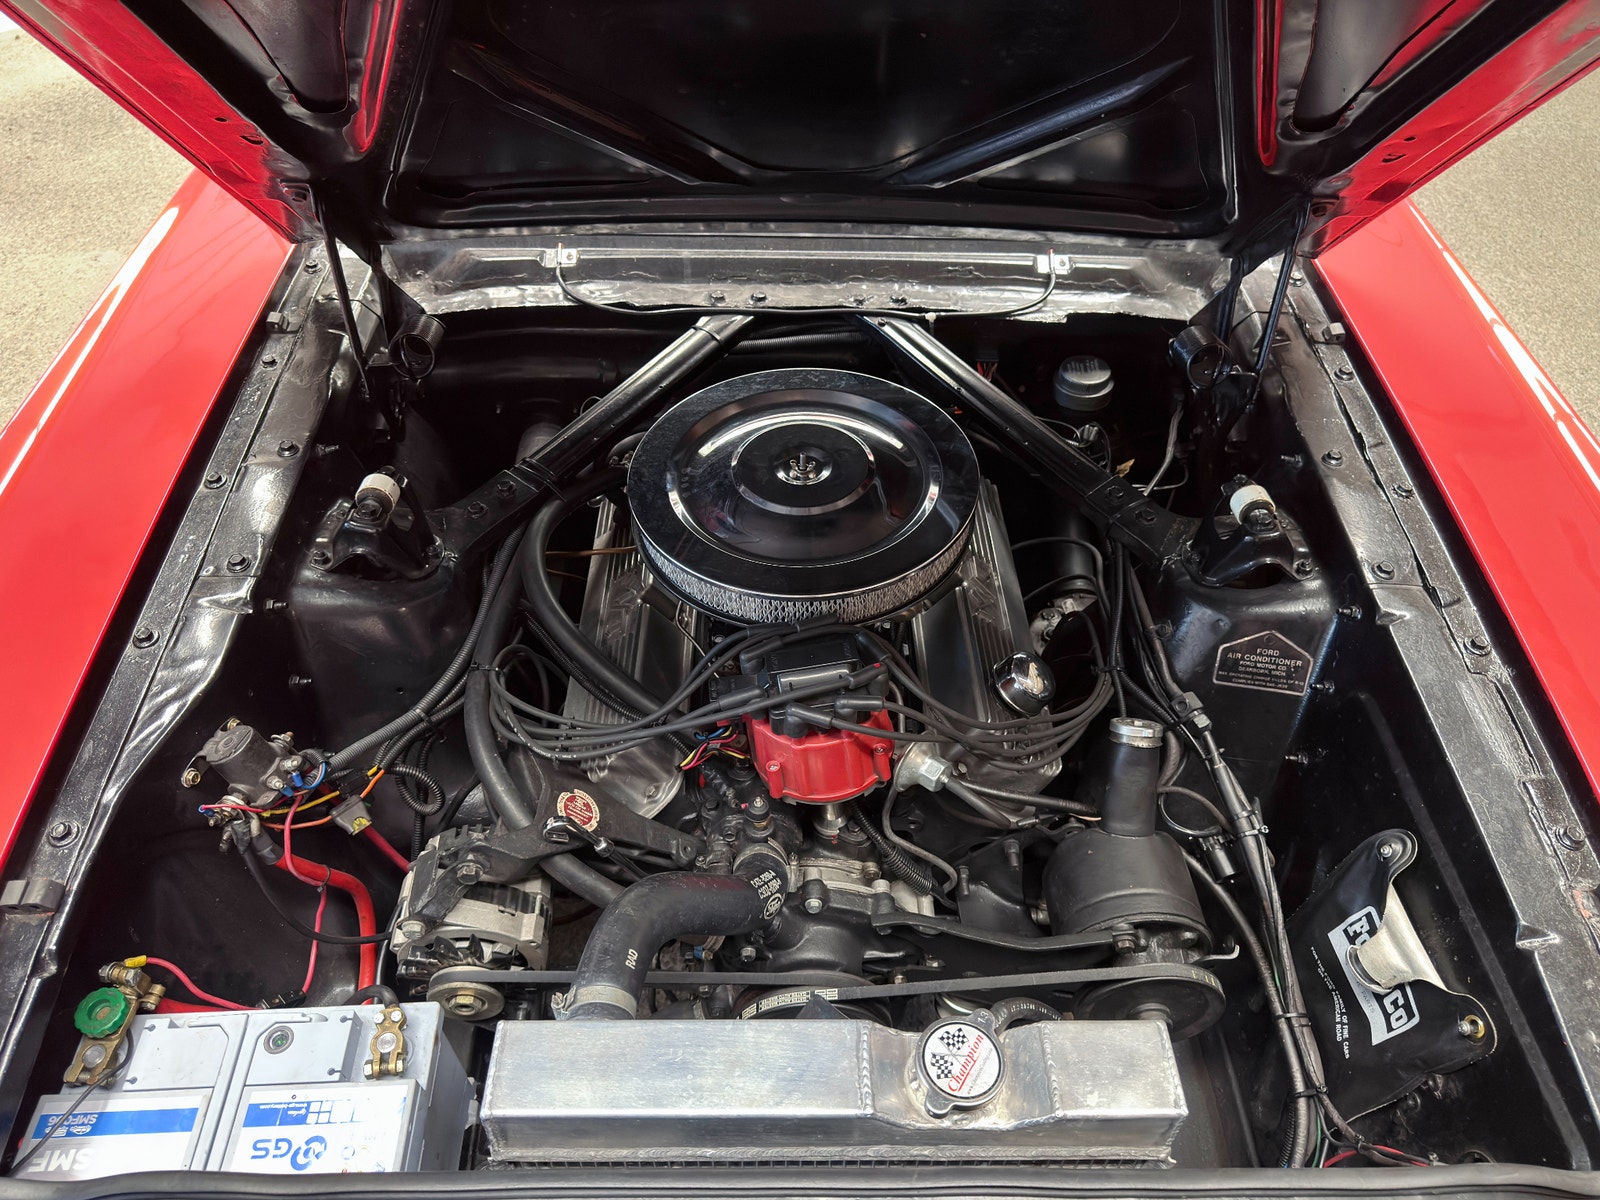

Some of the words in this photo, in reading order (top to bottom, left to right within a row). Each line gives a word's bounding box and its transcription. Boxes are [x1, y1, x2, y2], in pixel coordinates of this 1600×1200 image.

[1244, 654, 1303, 667] CONDITIONER
[1257, 648, 1280, 657] FORD
[1256, 662, 1277, 670] MOTOR
[625, 948, 639, 970] RAD
[1331, 991, 1341, 1023] AMERICAN
[1341, 1015, 1349, 1024] OF
[1335, 1024, 1343, 1042] ROAD
[947, 1034, 984, 1092] Champion
[47, 1113, 99, 1127] SMF06
[250, 1137, 293, 1160] GS
[26, 1148, 95, 1173] SMF
